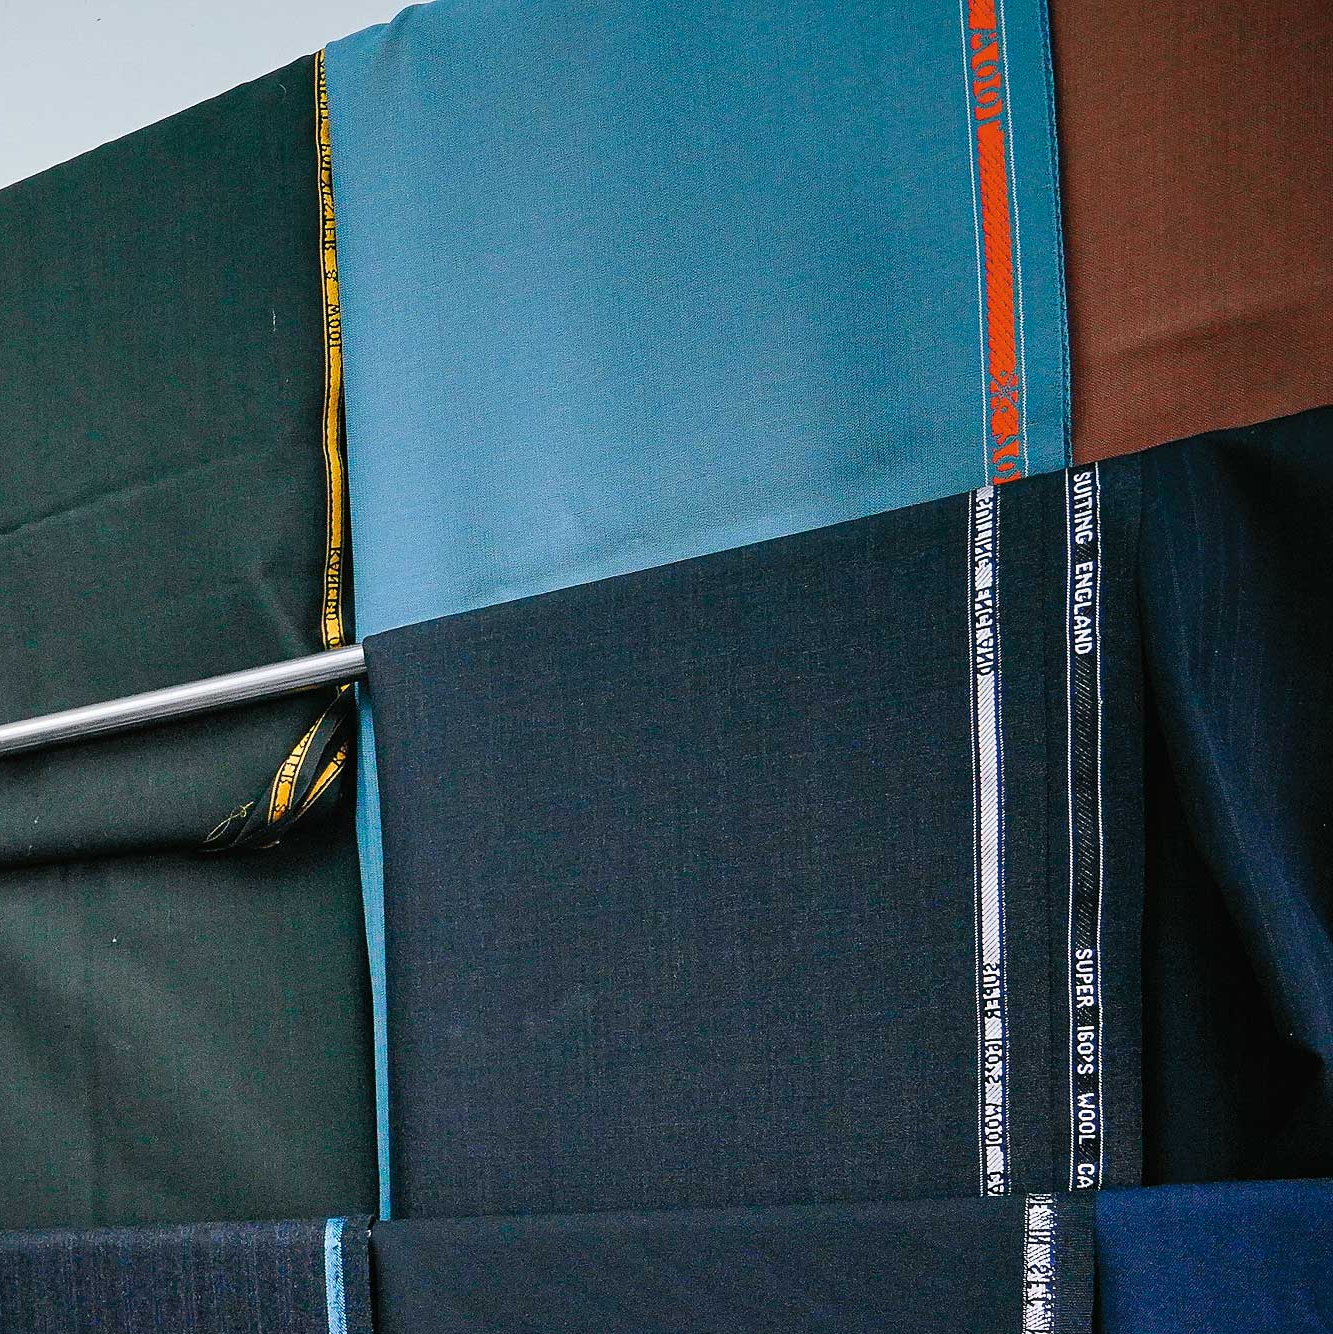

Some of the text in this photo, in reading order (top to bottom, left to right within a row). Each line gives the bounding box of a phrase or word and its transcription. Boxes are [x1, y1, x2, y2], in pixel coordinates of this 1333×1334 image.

[1072, 472, 1094, 656] SUITING ENGLAND
[1075, 948, 1093, 1009] SUPER
[1076, 1026, 1095, 1076] 160'S
[1077, 1093, 1096, 1147] WOOL
